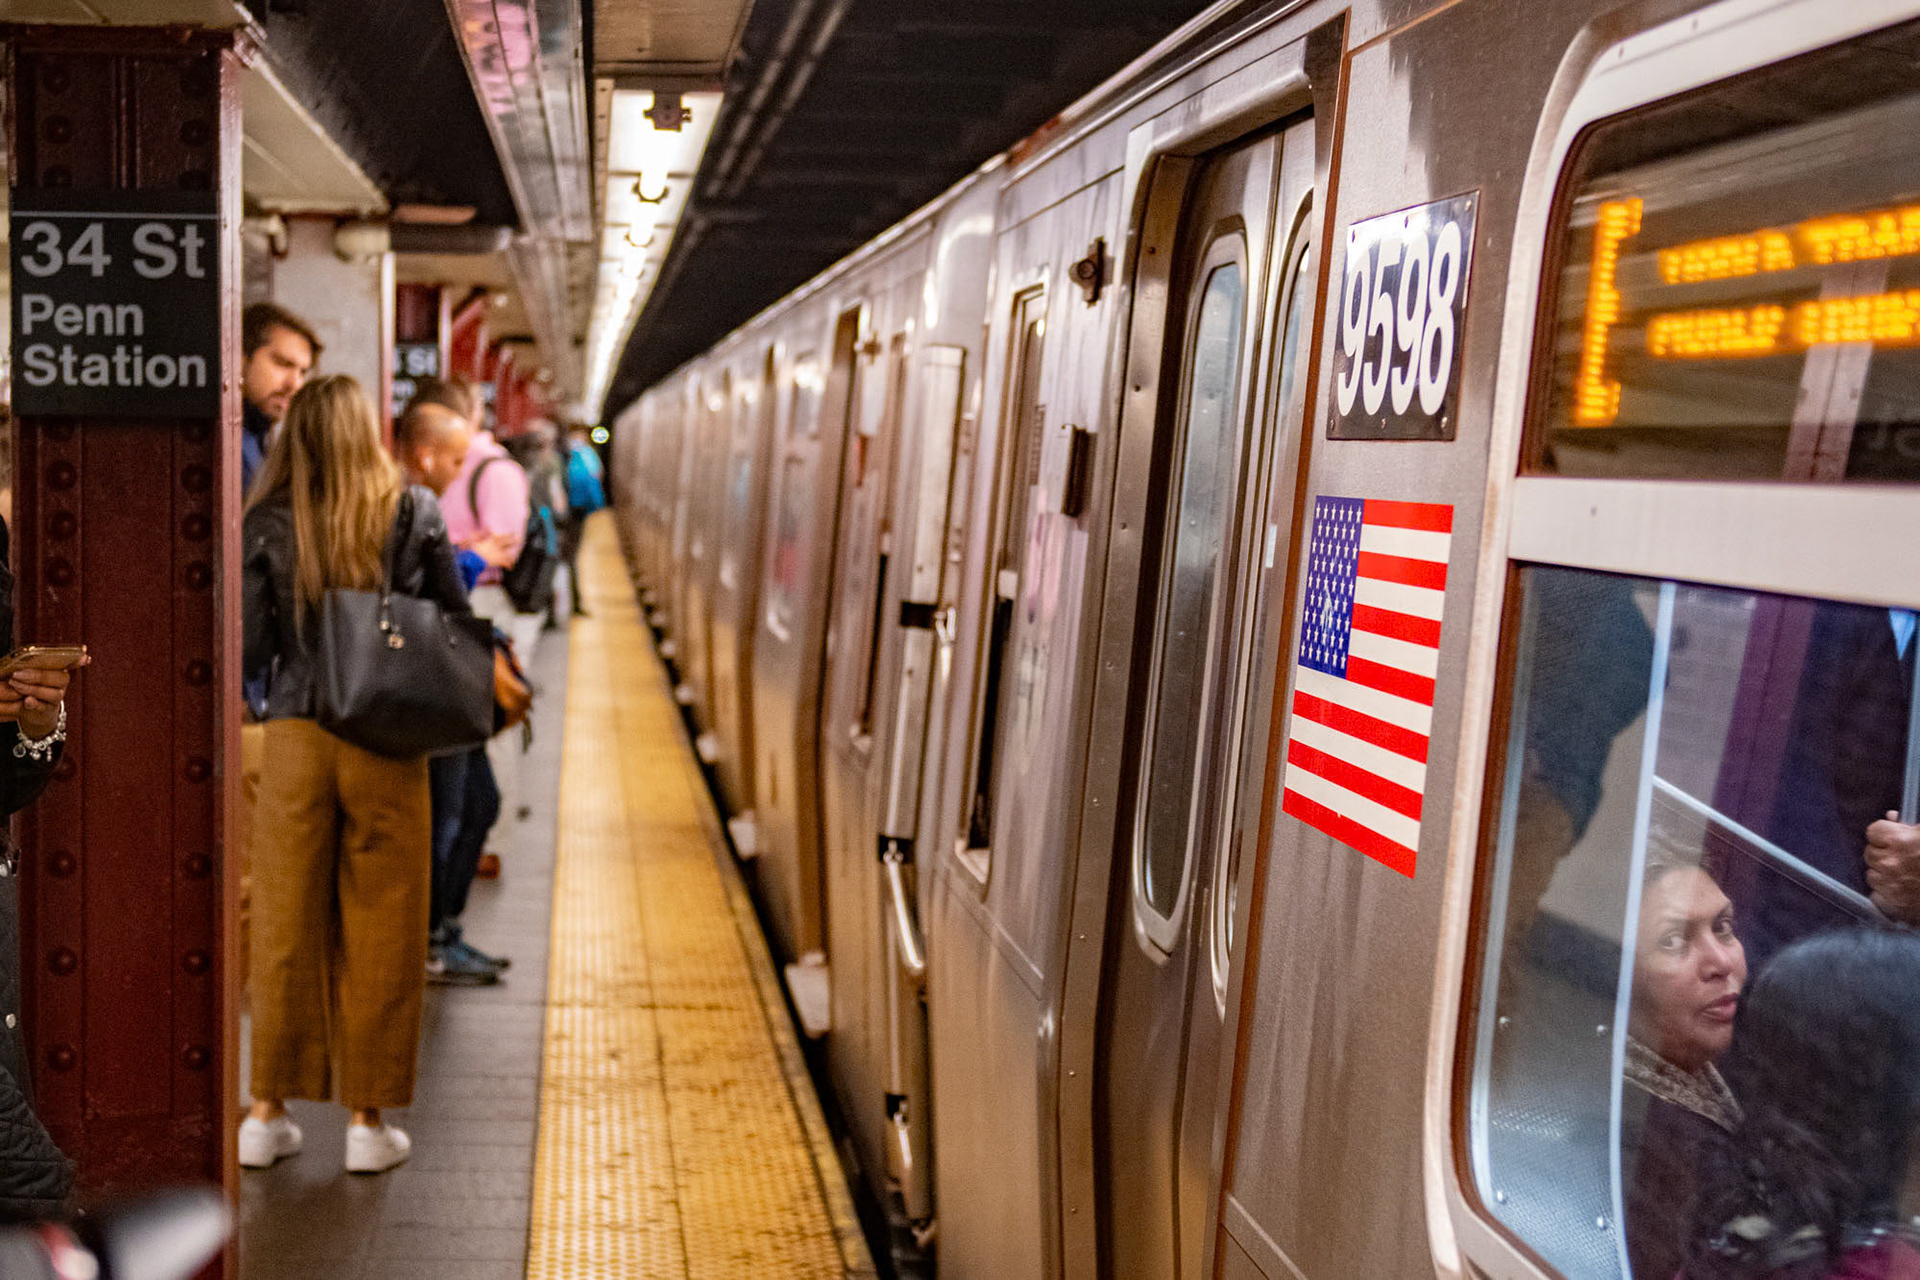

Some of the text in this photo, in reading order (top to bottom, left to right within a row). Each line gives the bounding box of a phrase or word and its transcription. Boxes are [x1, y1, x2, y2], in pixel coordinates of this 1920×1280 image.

[21, 221, 205, 279] 34 St
[21, 293, 144, 336] Penn
[1338, 221, 1462, 417] 9598
[23, 343, 206, 387] Station
